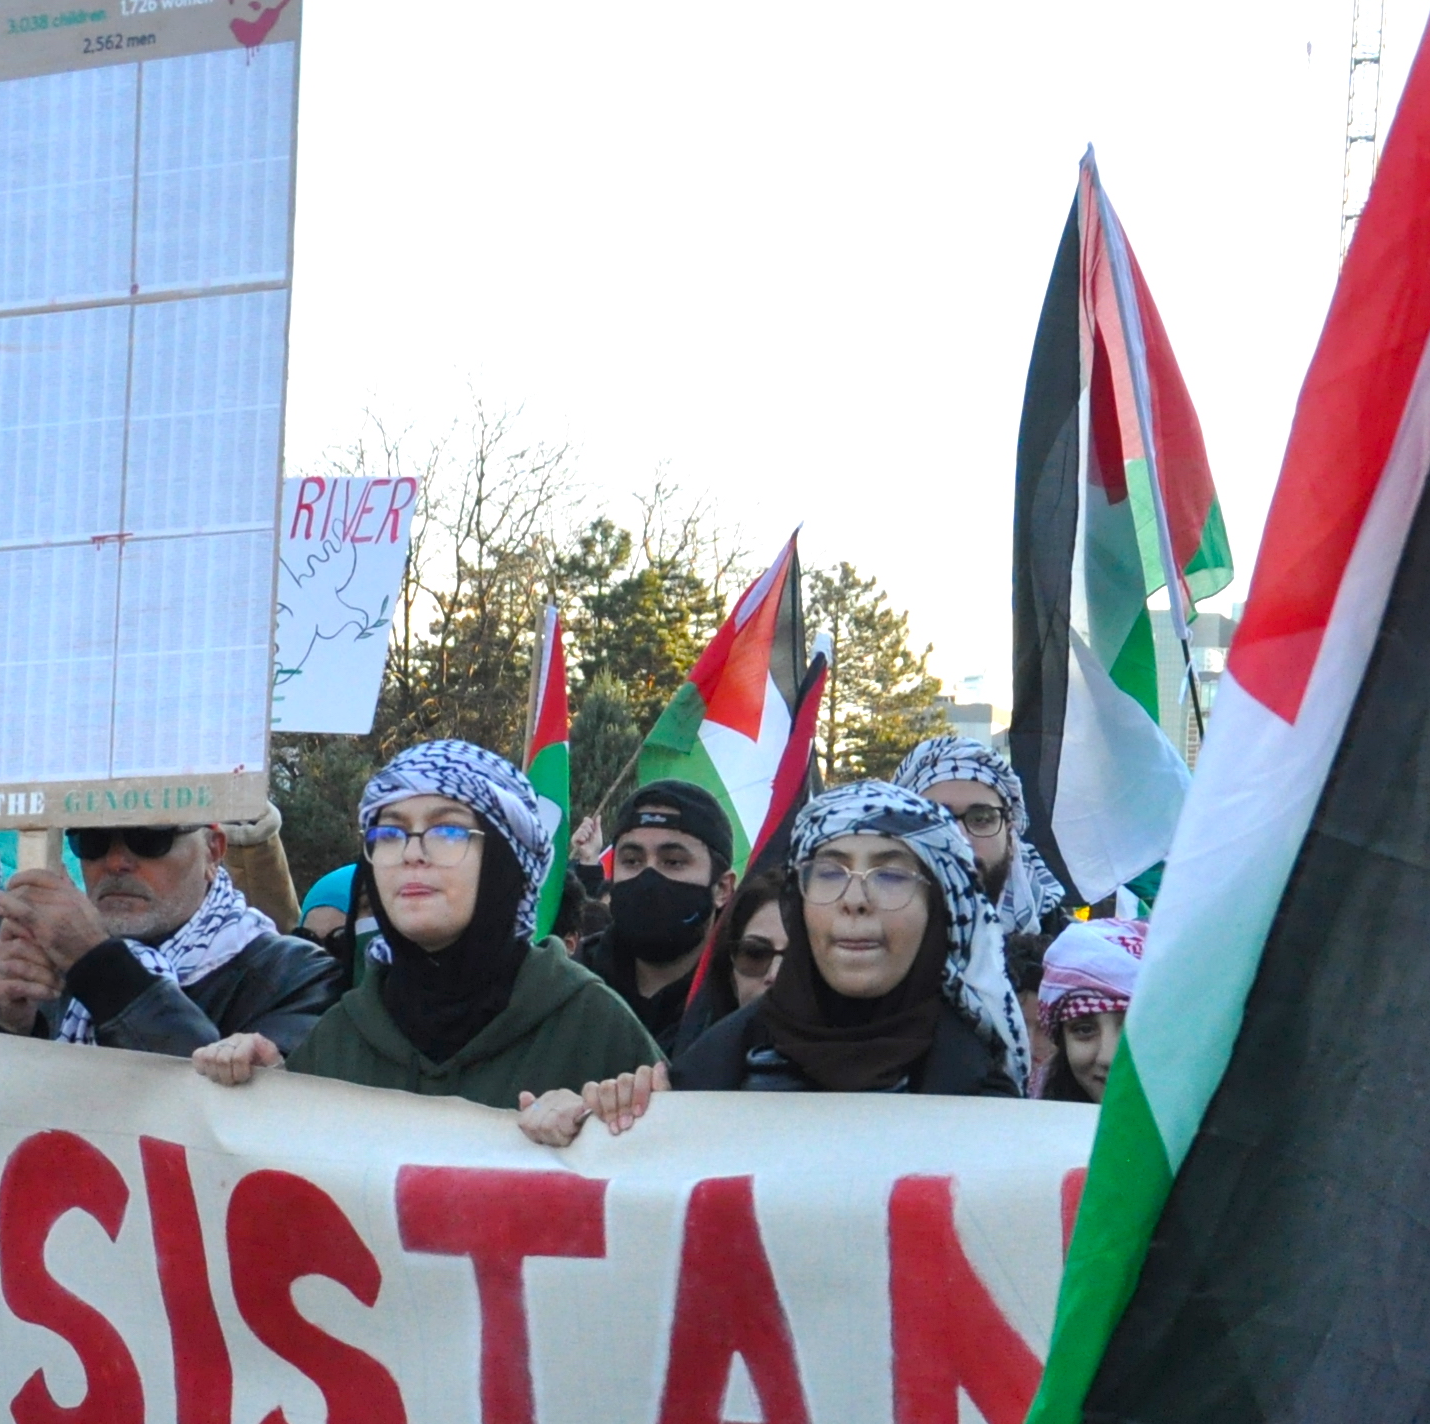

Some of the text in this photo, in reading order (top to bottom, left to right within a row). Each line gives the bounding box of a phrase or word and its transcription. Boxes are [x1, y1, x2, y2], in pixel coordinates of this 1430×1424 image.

[83, 33, 157, 55] 2,562 men
[290, 476, 418, 544] RIVER
[64, 784, 213, 814] GENOCIDE
